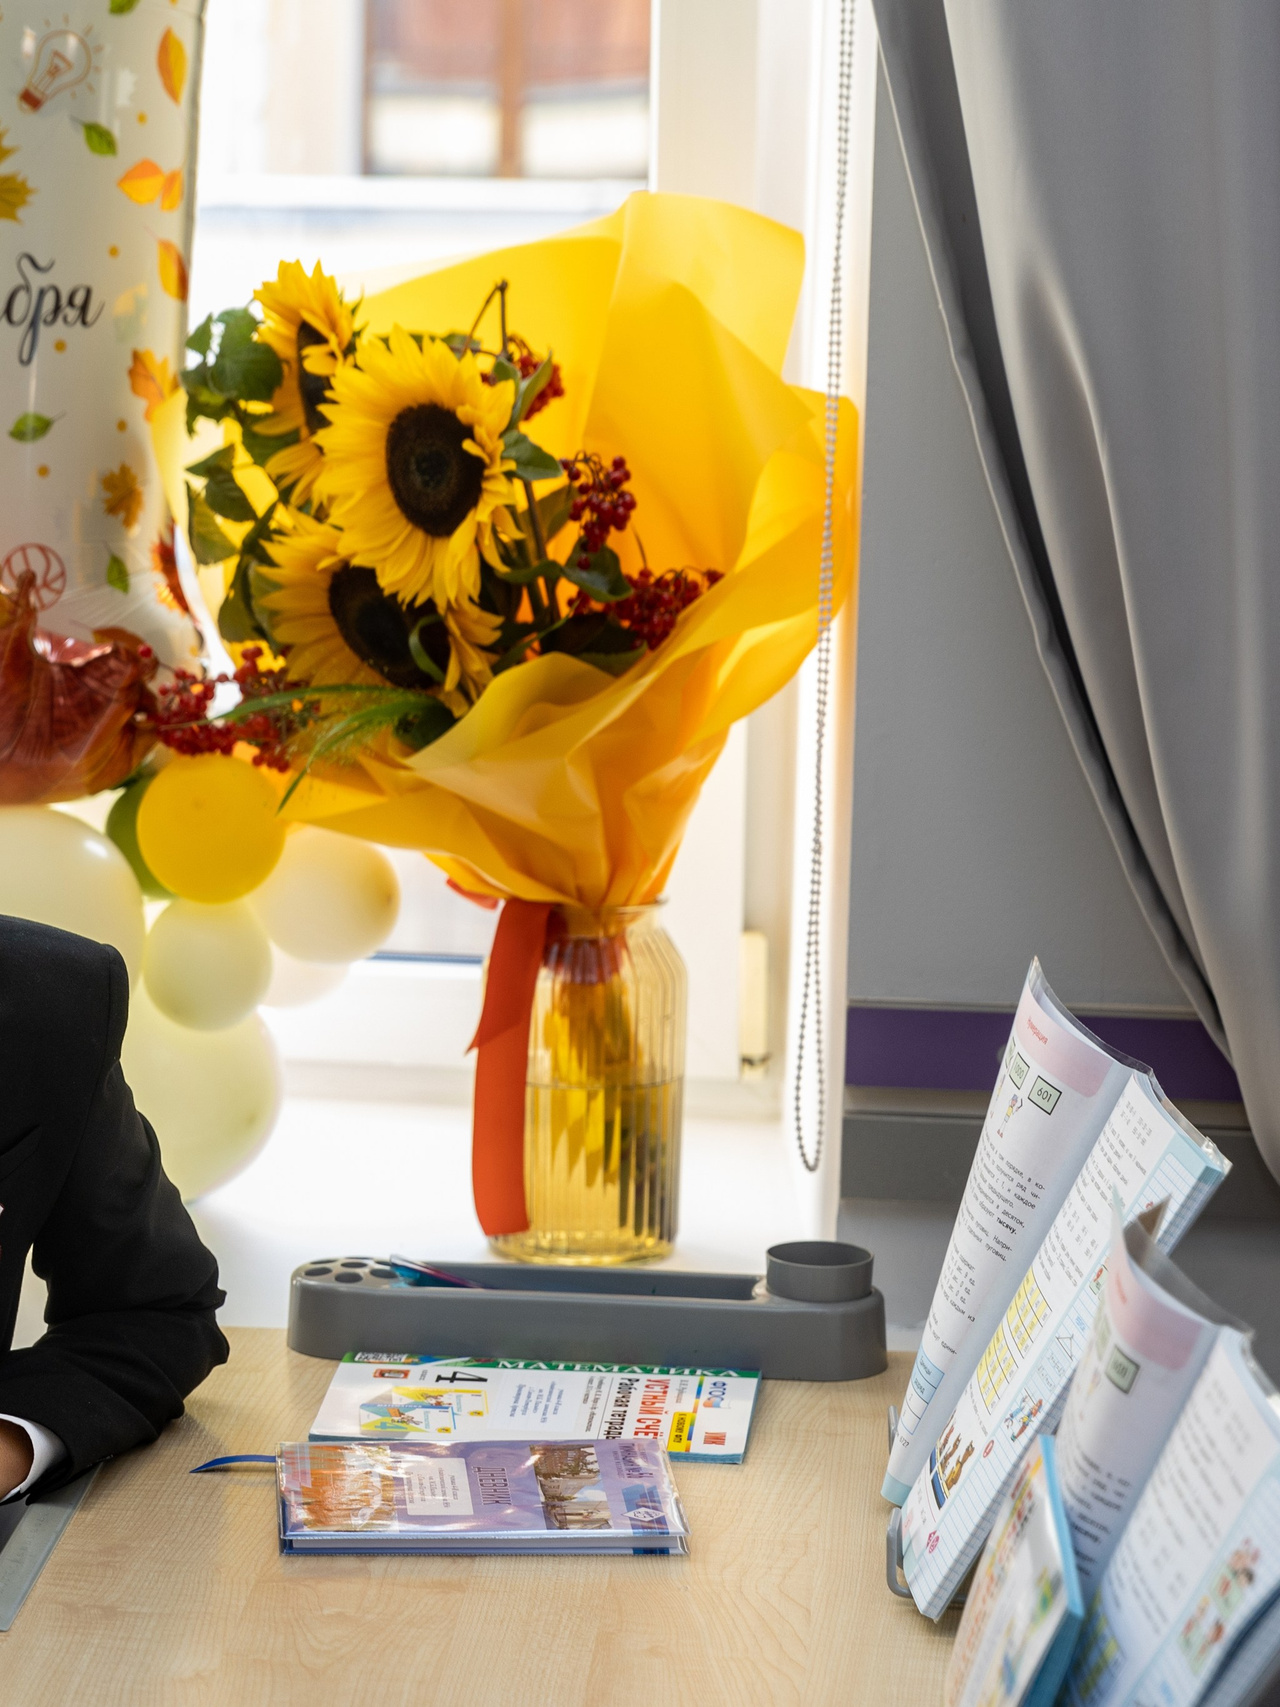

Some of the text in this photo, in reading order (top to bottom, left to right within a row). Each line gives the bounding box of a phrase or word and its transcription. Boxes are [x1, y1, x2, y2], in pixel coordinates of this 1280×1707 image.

[1036, 1087, 1052, 1103] 601
[1016, 1181, 1026, 1192] ряд
[1030, 1190, 1040, 1200] чи-
[1035, 1181, 1044, 1191] ко-
[1014, 1191, 1035, 1211] каждое
[996, 1217, 1016, 1235] тысячу.
[1002, 1208, 1025, 1228] десяток,
[985, 1242, 1006, 1263] пуговиц.
[993, 1235, 1012, 1253] Напри-
[967, 1313, 975, 1322] из
[941, 1340, 957, 1356] едини-
[435, 1371, 488, 1383] 4
[498, 1360, 740, 1377] МАТЕМАТИКА
[638, 1379, 670, 1415] УСТНЫЙ
[604, 1377, 640, 1439] Рабочая тетрадь
[703, 1432, 727, 1445] УМК
[472, 1465, 512, 1505] ДНЕВНИК
